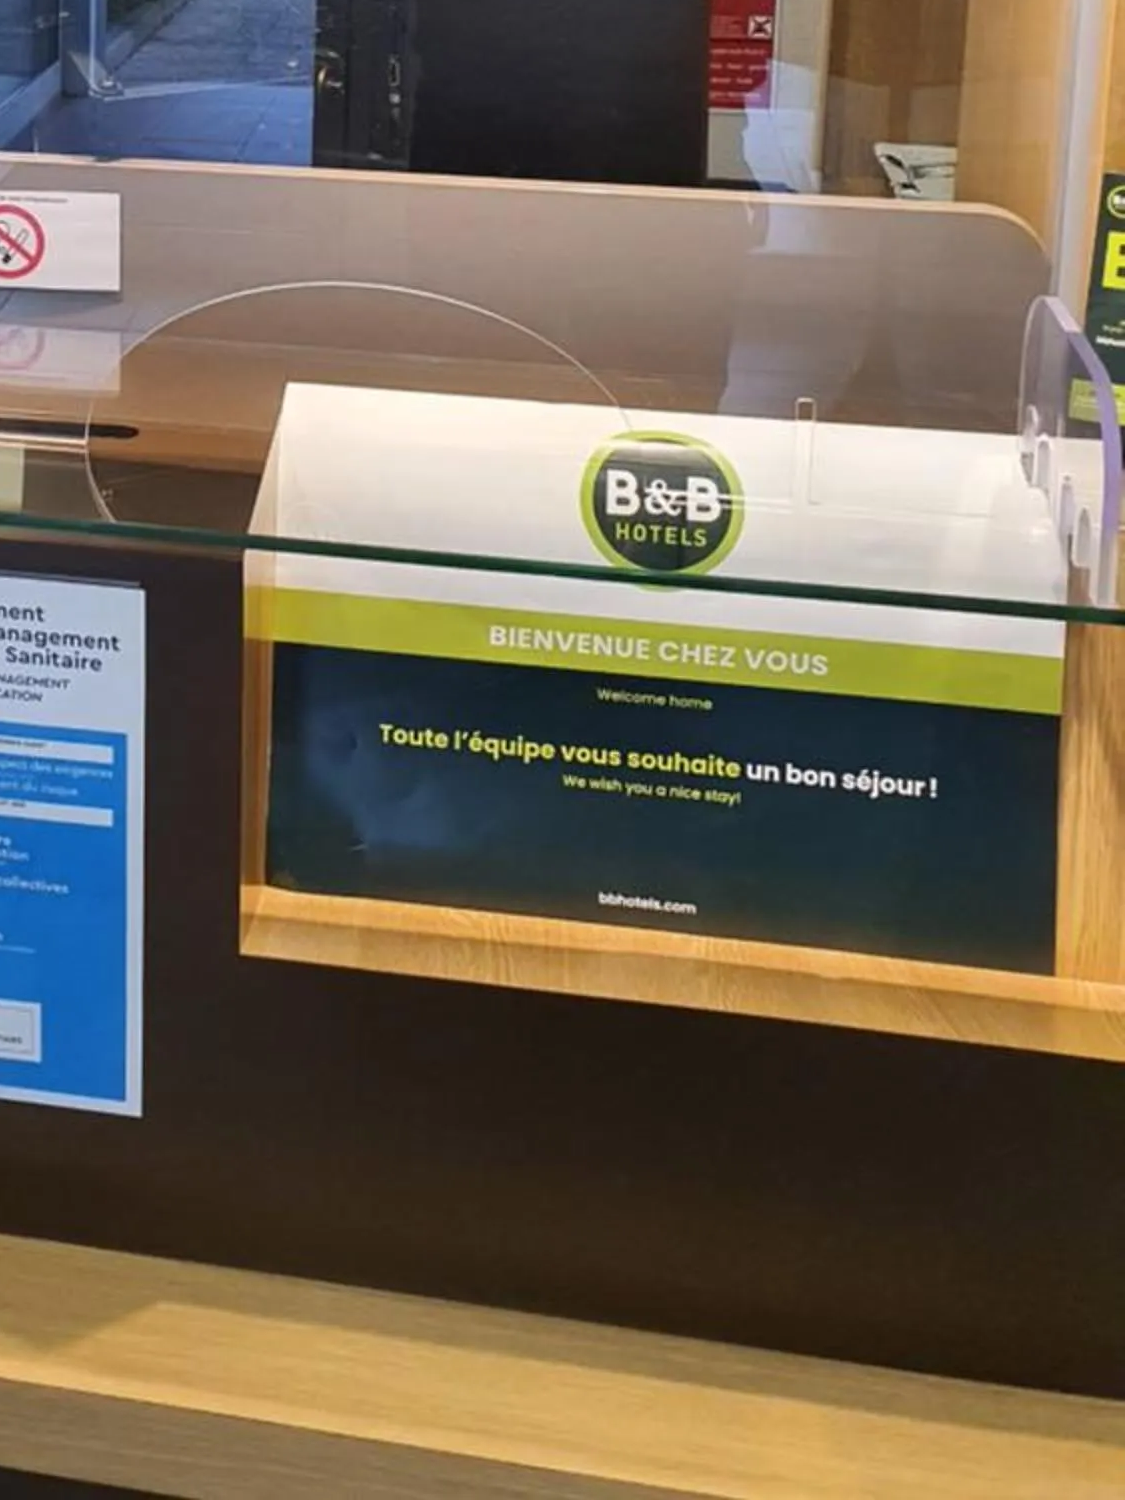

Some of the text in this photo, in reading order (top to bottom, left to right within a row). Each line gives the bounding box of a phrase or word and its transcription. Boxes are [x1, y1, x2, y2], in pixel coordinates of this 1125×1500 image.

[605, 468, 722, 523] B&B
[615, 522, 708, 548] HOTELS
[5, 646, 103, 672] Sanitaire
[489, 625, 829, 677] BIENVENUE CHEZ VOUS
[596, 686, 713, 711] Welcome home
[379, 723, 449, 750] Toute
[454, 729, 556, 765] l'équipe
[561, 743, 621, 767] vous
[627, 750, 742, 779] souhaite
[745, 760, 781, 784] un
[785, 762, 837, 789] bon
[562, 773, 586, 789] We
[589, 777, 622, 792] wish
[625, 783, 653, 797] you
[656, 785, 666, 797] a
[669, 784, 702, 801] nice
[597, 890, 698, 916] bbhotels.com
